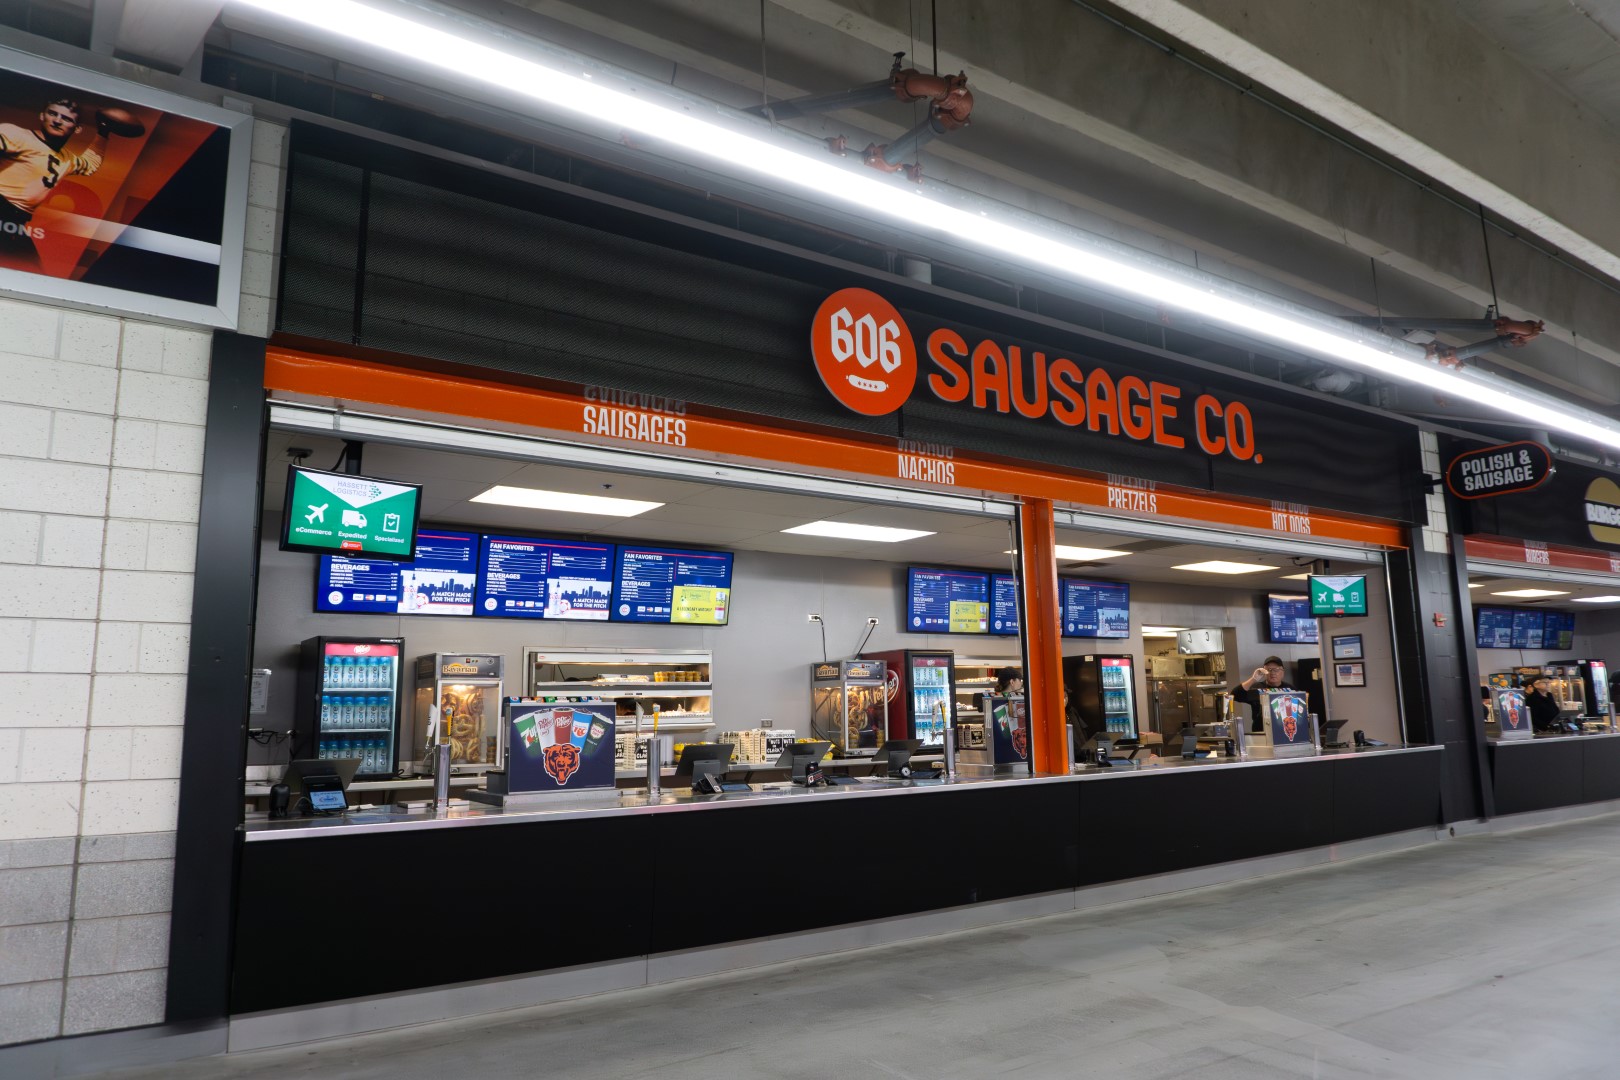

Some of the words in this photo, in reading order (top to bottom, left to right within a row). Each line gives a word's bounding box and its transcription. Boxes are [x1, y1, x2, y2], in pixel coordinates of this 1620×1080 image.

[830, 306, 902, 374] 606
[926, 327, 1185, 449] SAUSAGE
[1194, 393, 1264, 465] CO.
[583, 404, 687, 447] SAUSAGES
[897, 454, 955, 486] NACHOS
[1461, 452, 1515, 476] POLISH
[1519, 449, 1532, 465] &
[337, 480, 368, 490] HASSETT
[1464, 465, 1534, 492] SAUSAGE
[332, 487, 367, 497] LOGISTICS
[1107, 486, 1157, 514] PRETZELS
[295, 526, 332, 536] eCommerce
[337, 530, 367, 540] Expedited
[374, 535, 404, 544] Specialized
[1271, 512, 1288, 531] HOT
[1289, 515, 1311, 535] DOGS
[502, 544, 534, 552] FAVORITES
[330, 563, 371, 571] BEVERAGES
[487, 571, 521, 580] BEVERAGES
[443, 665, 477, 673] Bavarian
